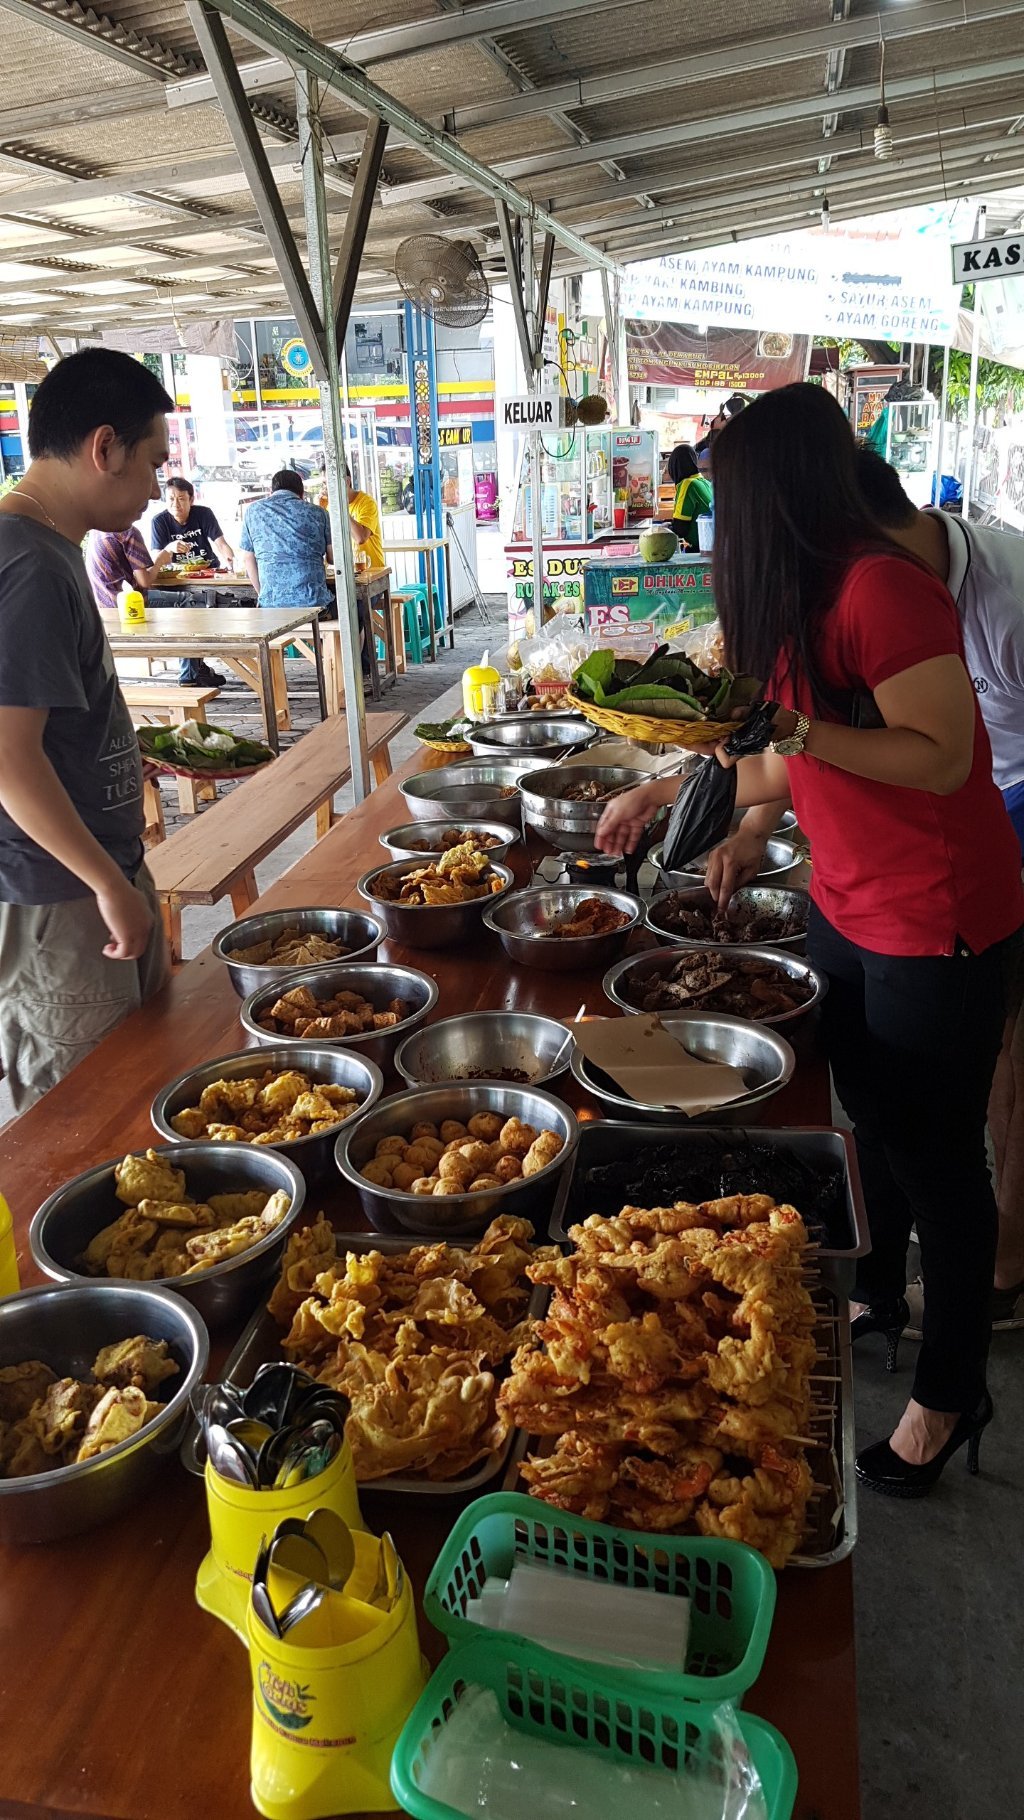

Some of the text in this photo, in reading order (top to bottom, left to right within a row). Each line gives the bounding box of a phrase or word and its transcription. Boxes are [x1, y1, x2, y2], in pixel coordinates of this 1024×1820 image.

[963, 244, 1024, 272] KAS
[680, 277, 744, 295] KAMBING
[641, 294, 679, 309] AYAM
[683, 298, 752, 316] KAMPUNG
[840, 291, 932, 310] SAYUR ASEM
[836, 312, 940, 331] AYAM GORENG
[504, 400, 553, 425] KELUAR
[515, 580, 581, 598] RUAK ES
[643, 574, 696, 589] DHIKA
[588, 604, 630, 627] ES
